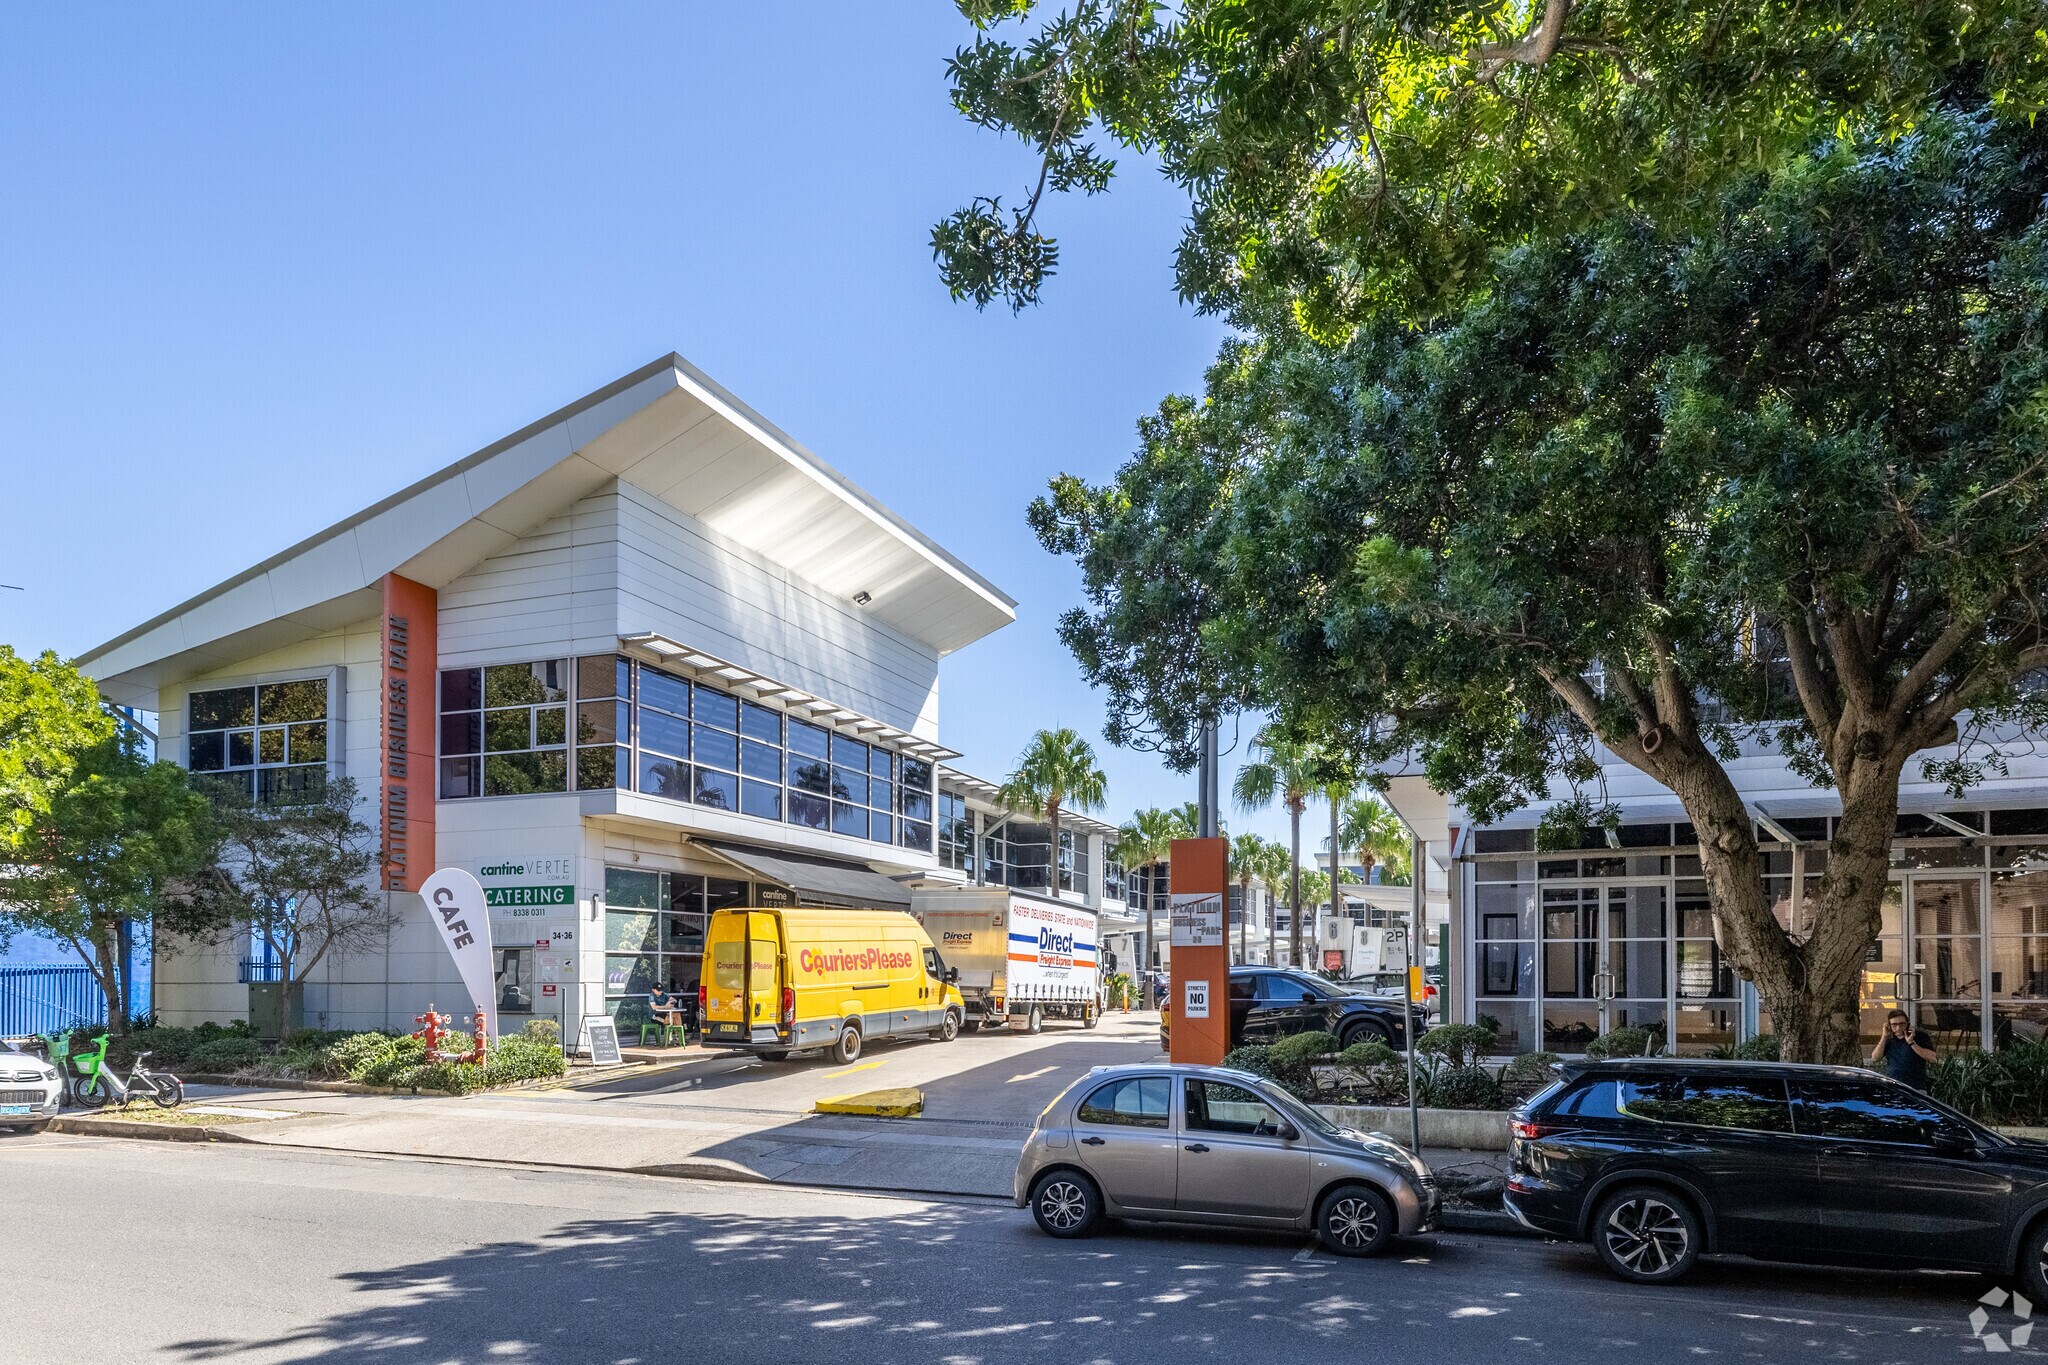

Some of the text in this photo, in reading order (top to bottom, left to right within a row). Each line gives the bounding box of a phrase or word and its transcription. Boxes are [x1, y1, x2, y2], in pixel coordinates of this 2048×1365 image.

[388, 613, 408, 891] PLATINUM BUSINESS PARK
[480, 859, 570, 876] cantine VERTE
[485, 887, 565, 905] CATERING
[762, 889, 787, 901] cantine
[503, 908, 546, 917] PH 8338 0311
[1013, 904, 1030, 918] FASTER
[1030, 907, 1054, 922] DELIVERIES
[1054, 912, 1066, 925] STATE
[1173, 901, 1221, 914] PLATINUM
[433, 887, 475, 950] CAFE
[1173, 917, 1207, 927] BUSINESS
[943, 931, 973, 940] Direct
[1201, 926, 1221, 936] PARK
[1386, 931, 1404, 943] 2P
[1039, 926, 1073, 953] Direct
[800, 948, 912, 974] CouriersPlease
[1039, 953, 1072, 968] Freight Express
[1190, 993, 1204, 1004] NO
